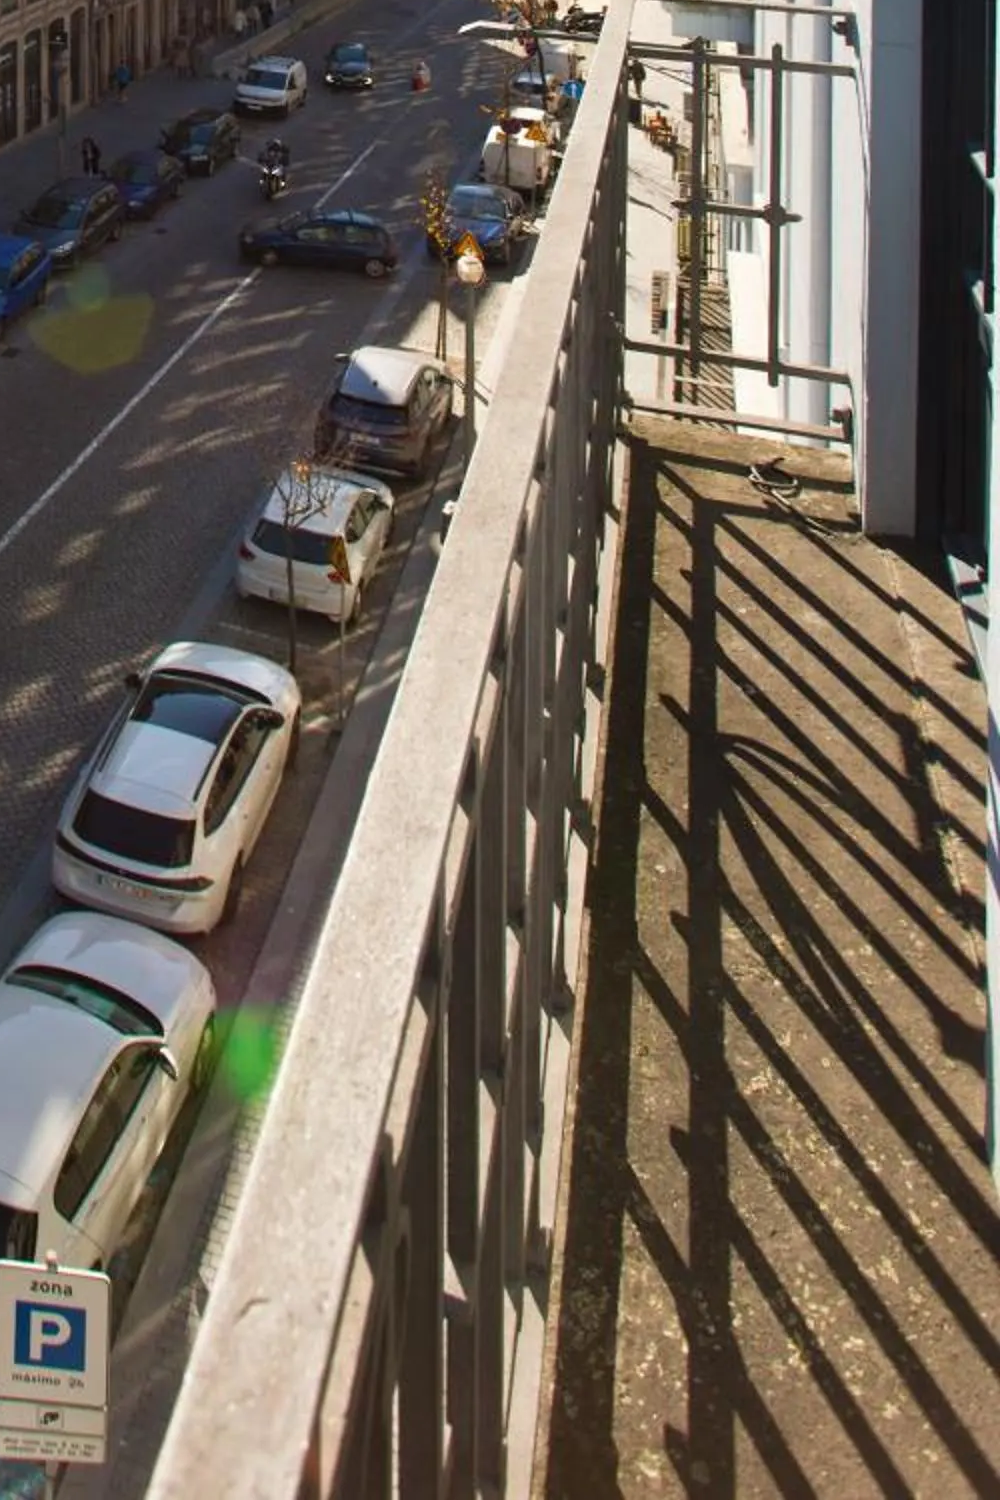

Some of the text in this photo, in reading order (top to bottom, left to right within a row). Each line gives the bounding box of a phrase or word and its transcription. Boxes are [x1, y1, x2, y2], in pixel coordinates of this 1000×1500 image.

[29, 1279, 73, 1296] zona
[29, 1309, 72, 1362] P
[12, 1371, 61, 1386] máximo
